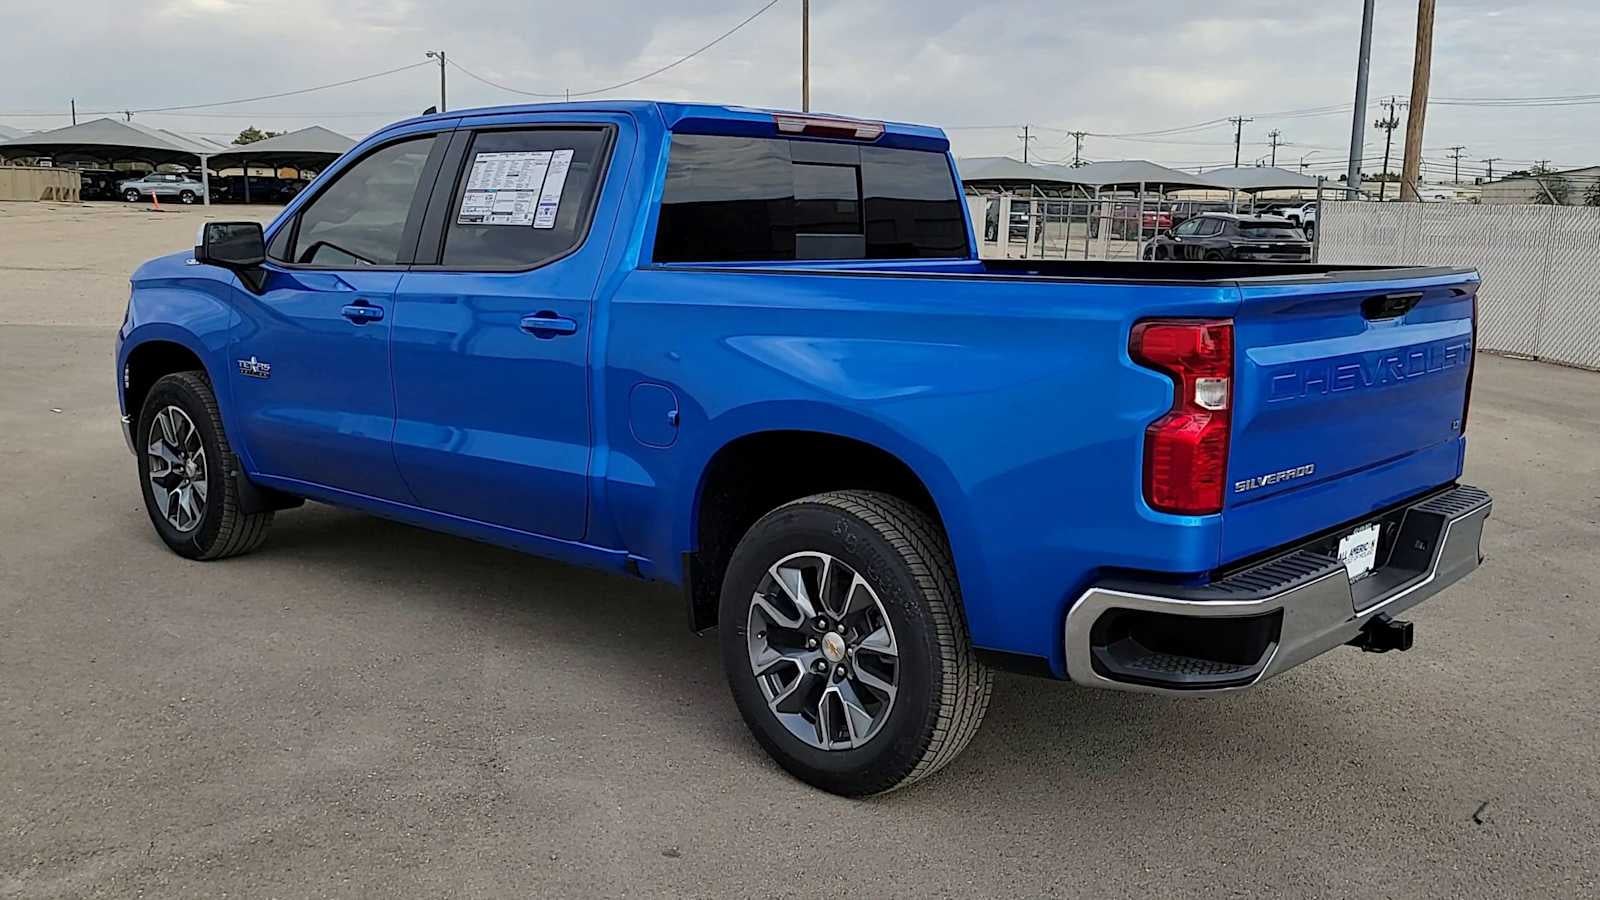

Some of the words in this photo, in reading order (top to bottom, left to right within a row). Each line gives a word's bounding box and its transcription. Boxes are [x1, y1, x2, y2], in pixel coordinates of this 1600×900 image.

[237, 357, 270, 371] TEXAS
[1267, 343, 1471, 403] CHEVROLET
[1234, 463, 1315, 493] SILVERADO
